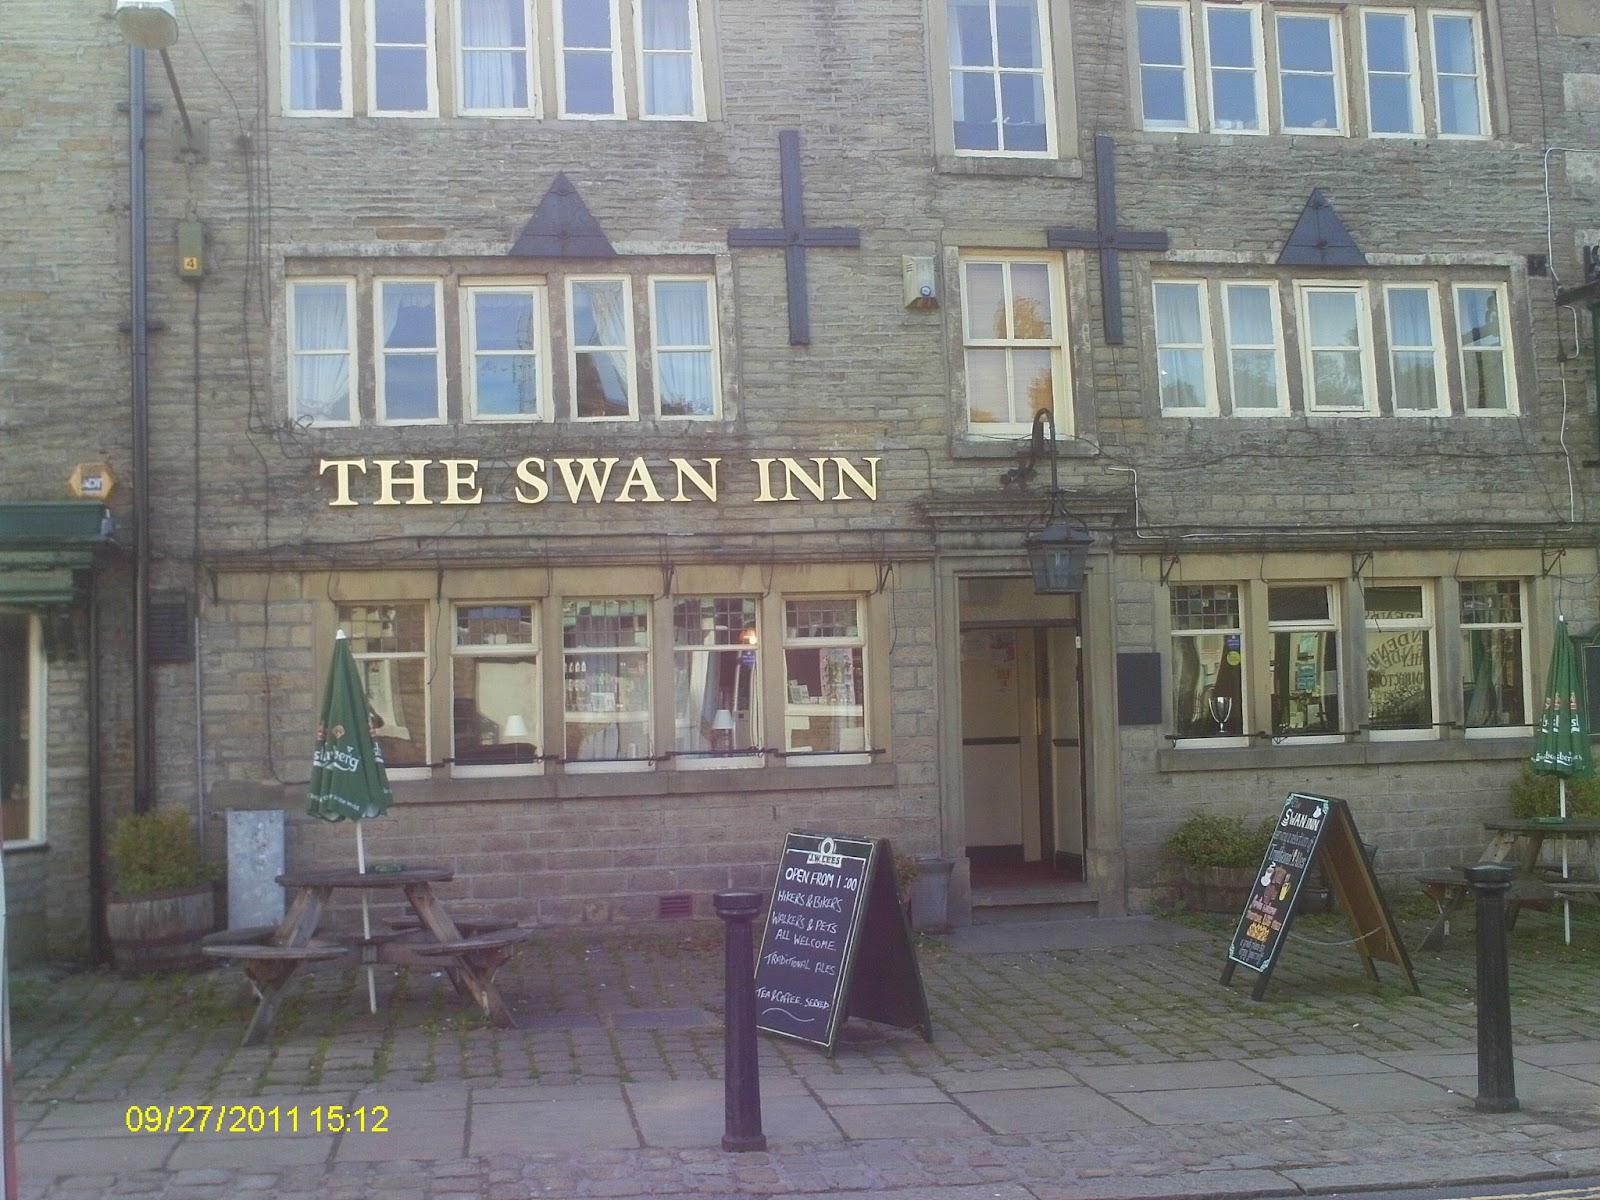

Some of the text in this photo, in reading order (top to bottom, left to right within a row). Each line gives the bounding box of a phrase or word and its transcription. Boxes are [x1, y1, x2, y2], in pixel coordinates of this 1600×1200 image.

[319, 456, 883, 506] THE SWAN INN
[1281, 808, 1320, 831] SWAN INN
[785, 867, 810, 884] OPEN
[810, 871, 835, 888] FROM
[771, 911, 838, 934] WALKERS & PETS
[775, 928, 790, 941] ALL
[814, 961, 836, 976] ALES
